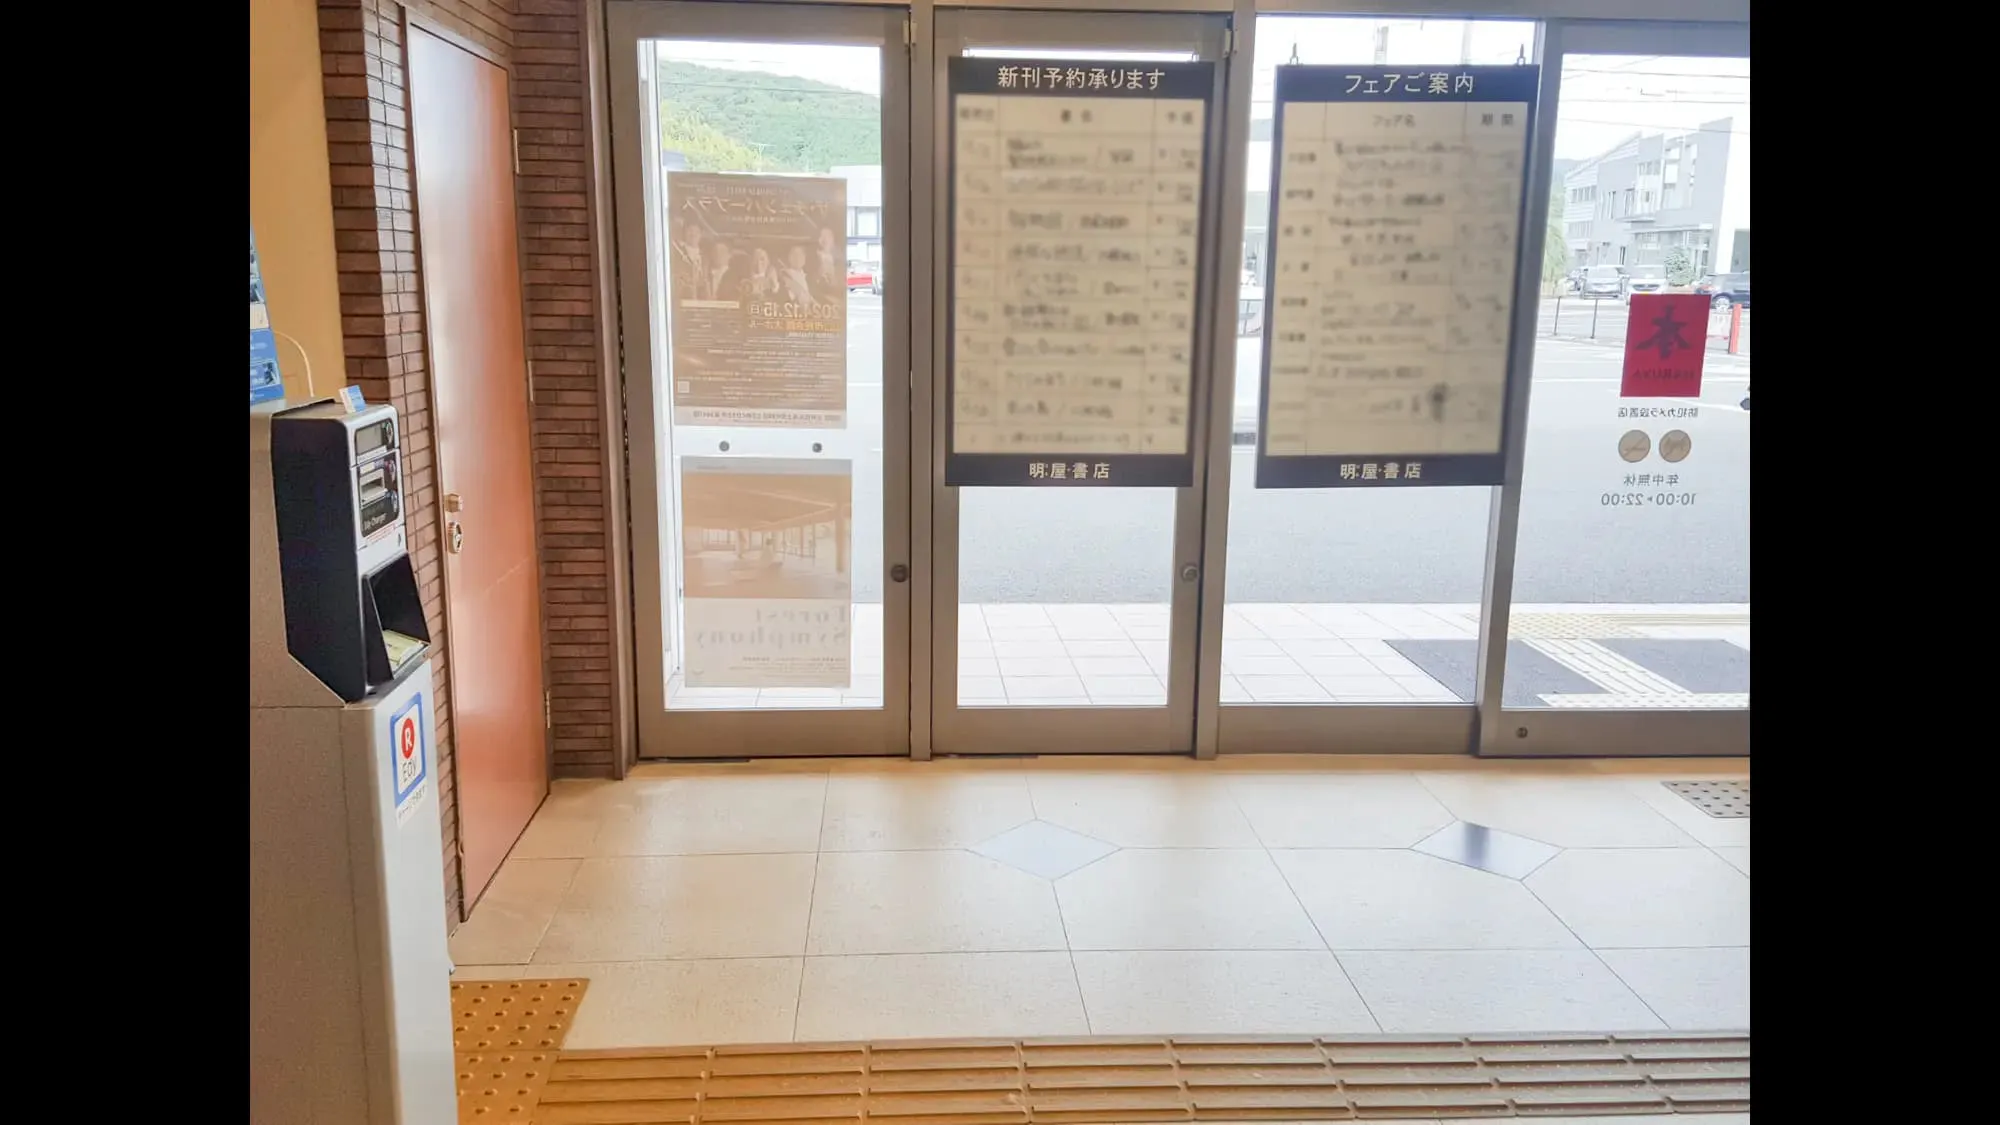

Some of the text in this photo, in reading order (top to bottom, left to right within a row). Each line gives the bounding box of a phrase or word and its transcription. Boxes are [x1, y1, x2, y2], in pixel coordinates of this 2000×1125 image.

[998, 66, 1165, 90] 新刊予約承ります
[1345, 72, 1474, 94] フェアご案内
